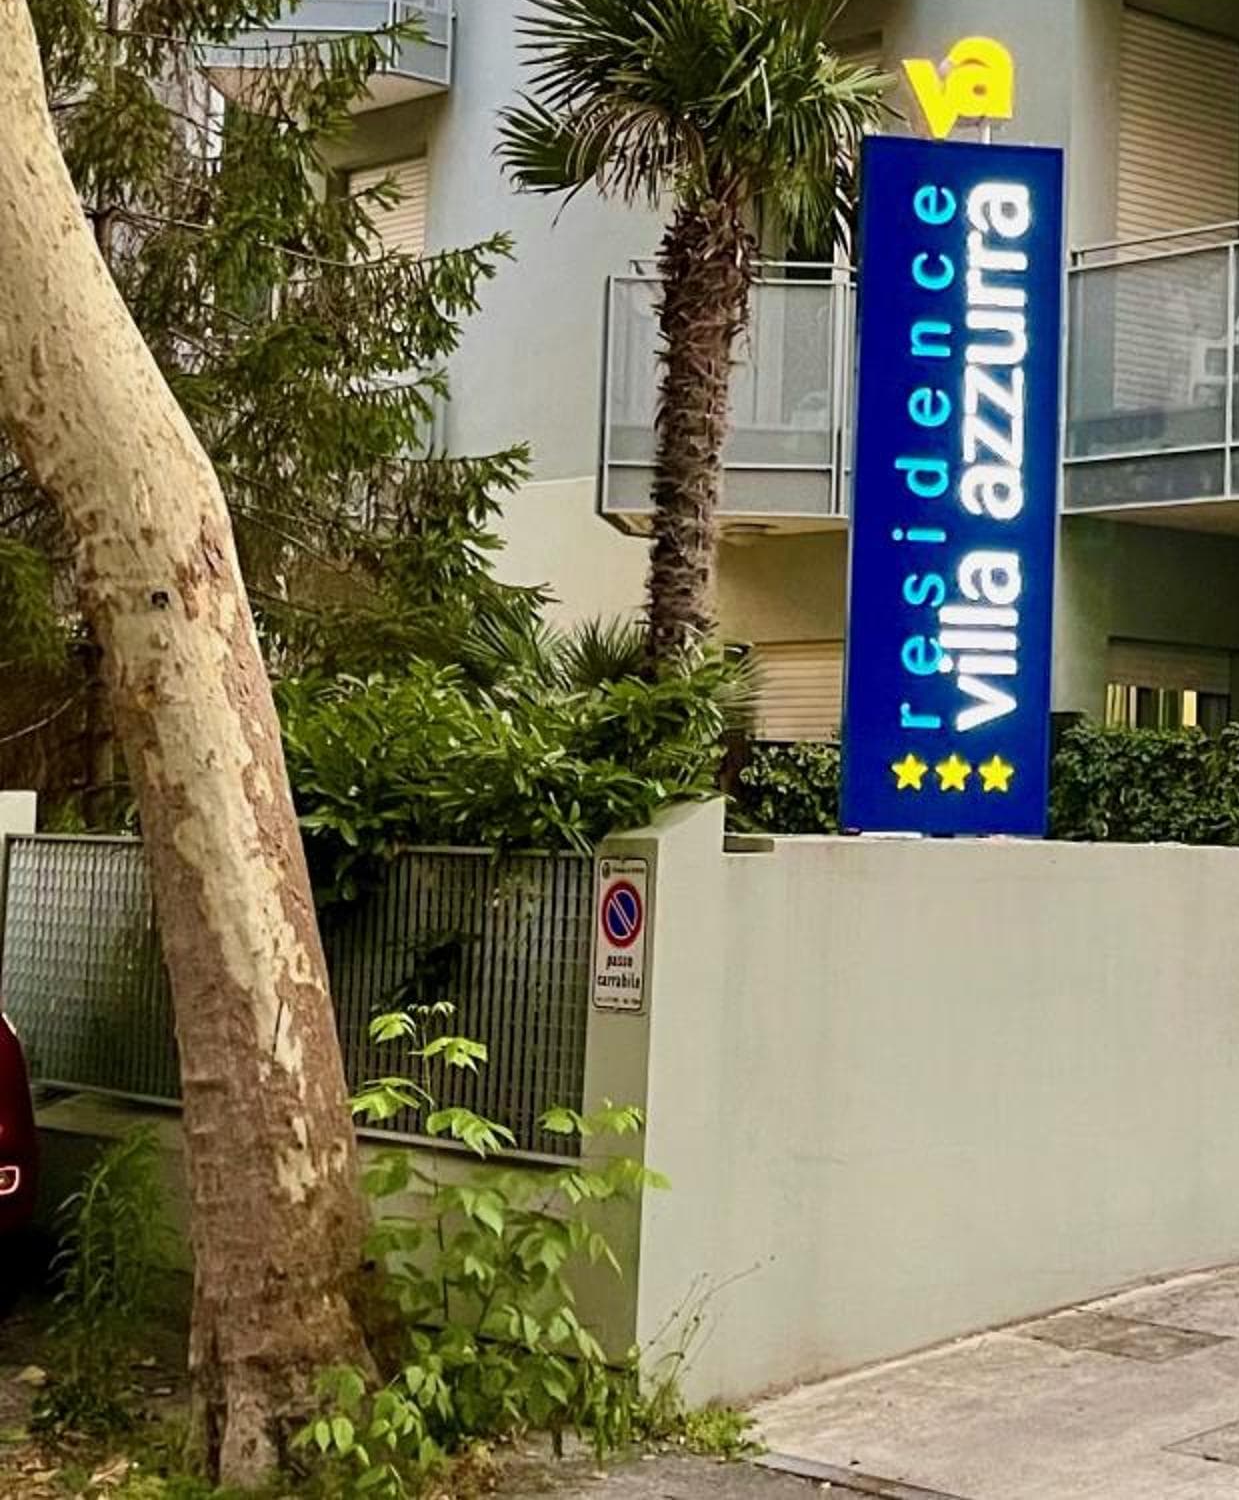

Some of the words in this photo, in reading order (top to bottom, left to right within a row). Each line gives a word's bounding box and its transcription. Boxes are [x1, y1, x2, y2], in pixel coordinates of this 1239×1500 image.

[903, 36, 1013, 139] va
[959, 181, 1031, 521] azzurra
[893, 185, 957, 730] residence
[938, 550, 1021, 732] villa
[598, 973, 640, 989] carrabile
[606, 955, 633, 969] passo
